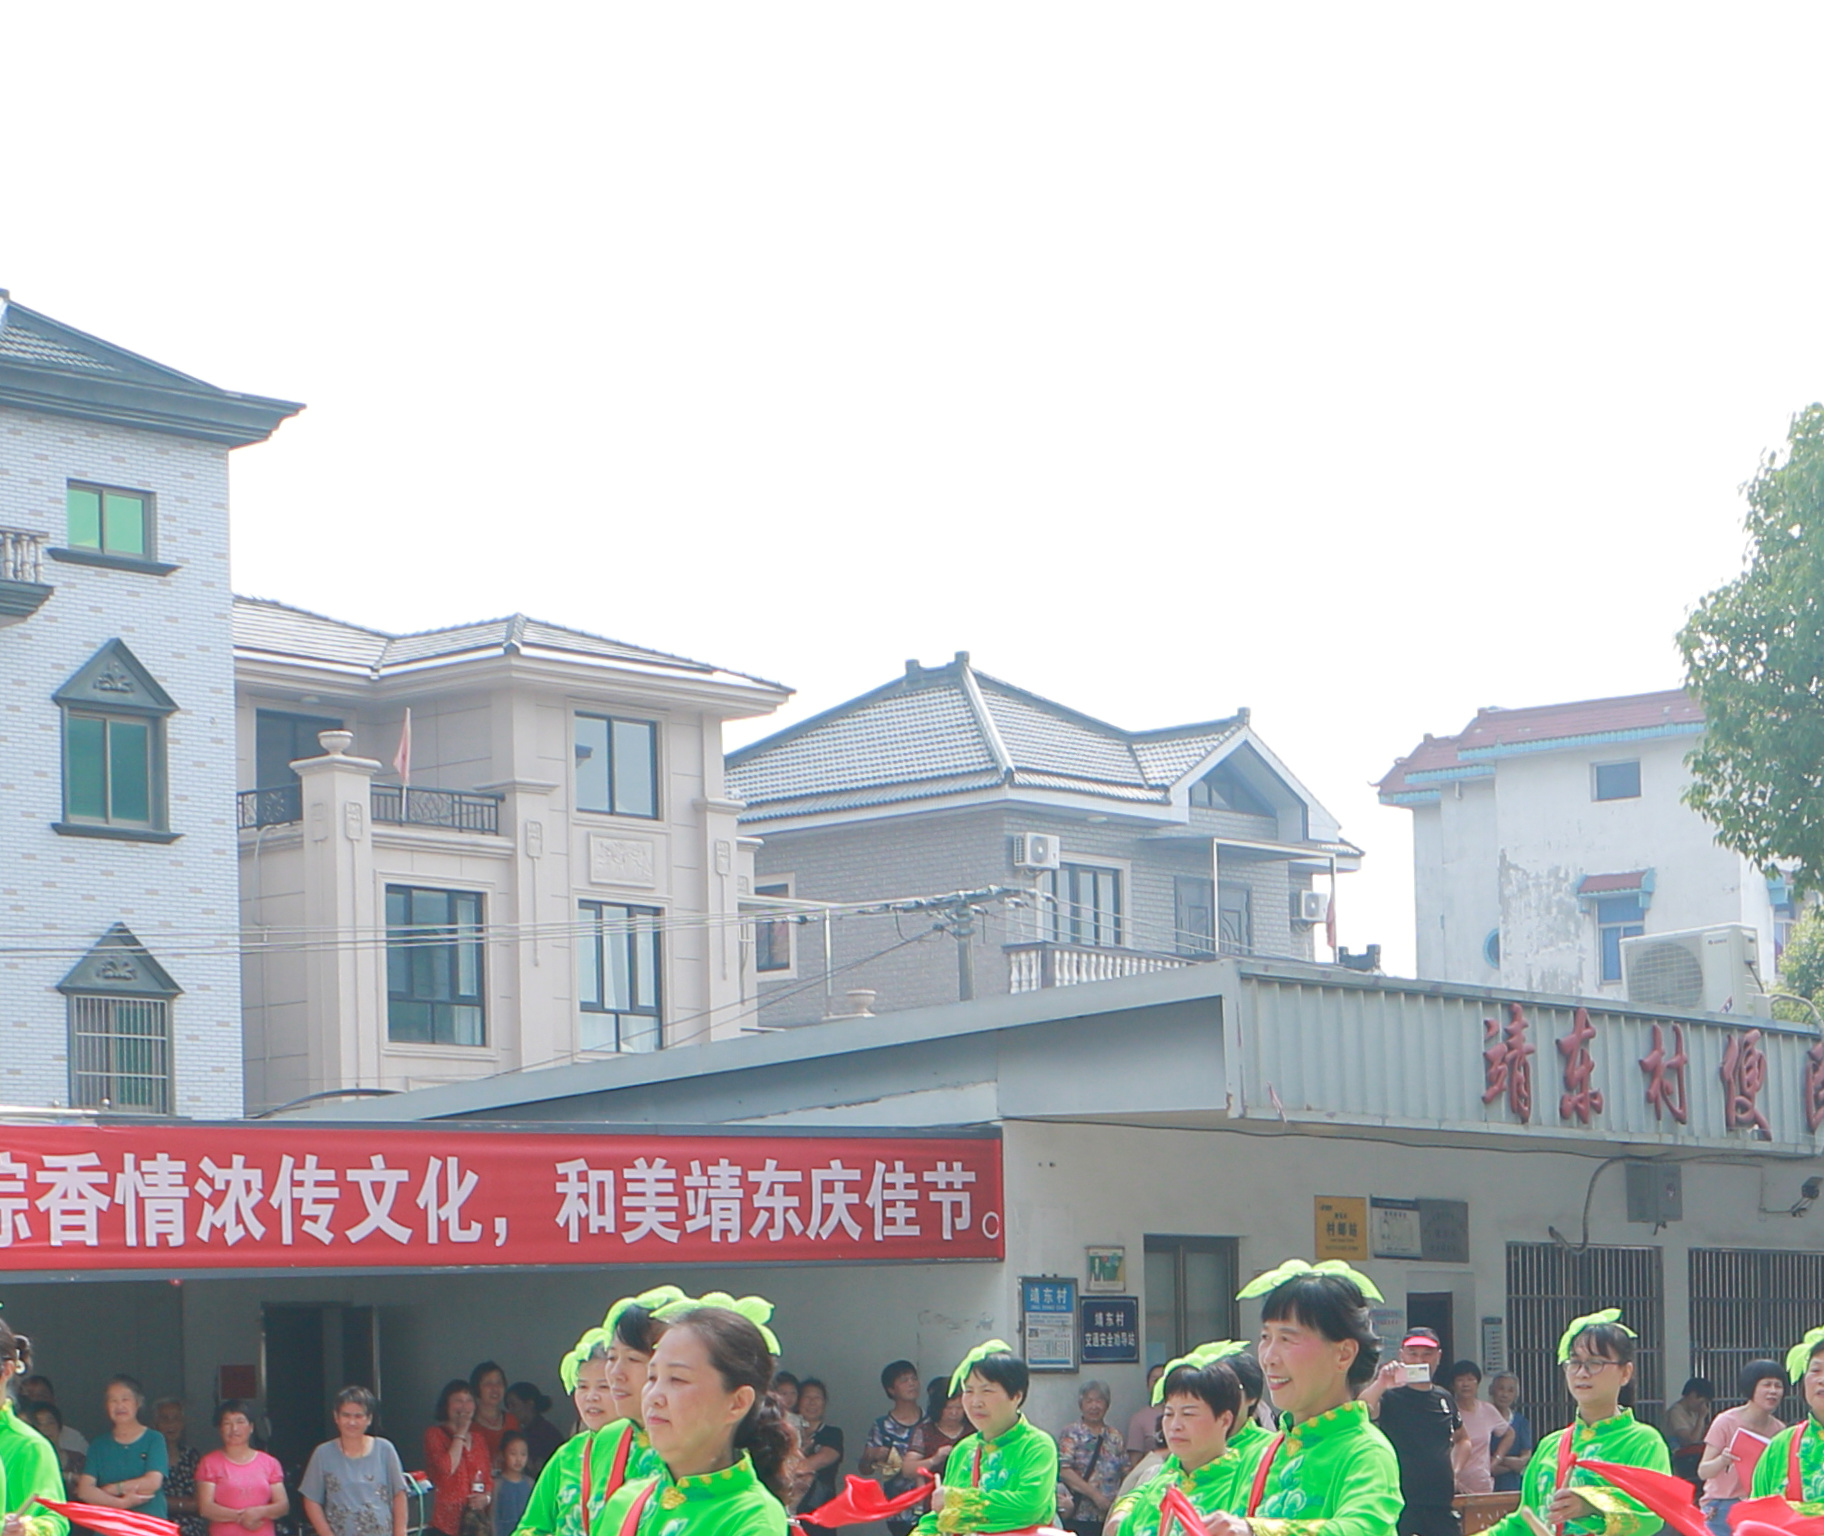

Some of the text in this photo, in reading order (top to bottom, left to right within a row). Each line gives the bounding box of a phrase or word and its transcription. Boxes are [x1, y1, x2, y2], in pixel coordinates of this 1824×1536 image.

[1030, 1287, 1067, 1304] 靖东村
[1094, 1312, 1124, 1327] 靖东村
